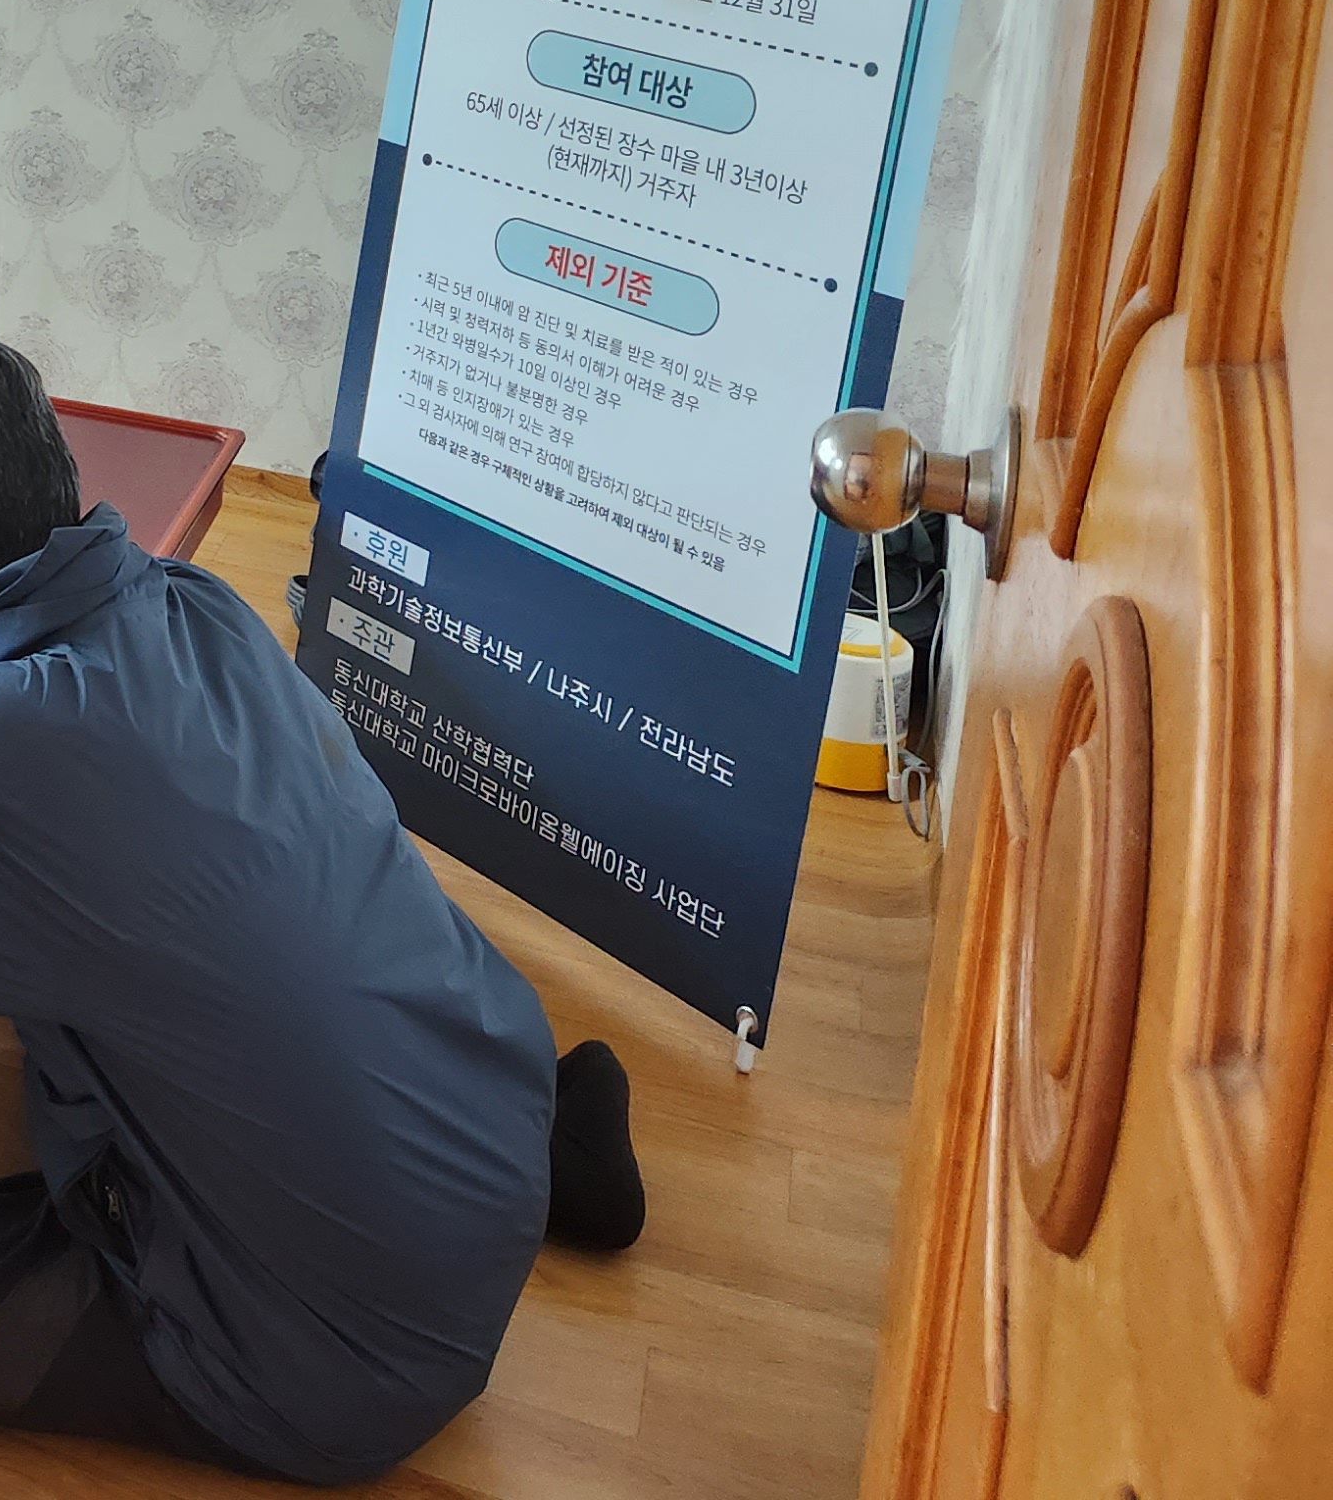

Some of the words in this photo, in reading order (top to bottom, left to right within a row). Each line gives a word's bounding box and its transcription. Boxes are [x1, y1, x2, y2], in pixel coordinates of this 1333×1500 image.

[582, 52, 634, 96] 참여
[637, 68, 694, 109] 대상
[465, 90, 504, 121] 65세
[506, 101, 544, 131] 이상
[557, 115, 613, 151] 선정된
[616, 130, 656, 162] 장수
[659, 143, 701, 176] 마을
[704, 156, 727, 184] 내
[728, 163, 808, 205] 3년이상
[547, 143, 632, 192] (현재까지)
[635, 170, 697, 209] 거주자
[545, 244, 595, 288] 제외
[600, 262, 653, 307] 기준
[411, 343, 461, 376] 거주지가
[464, 363, 502, 393] 없거나
[505, 379, 558, 415] 불분명한
[560, 402, 588, 425] 경우
[416, 318, 449, 344] 1년간
[450, 331, 514, 369] 와병일수가
[516, 357, 547, 382] 10일
[549, 369, 591, 399] 이상인
[593, 385, 621, 409] 경우
[419, 295, 446, 318] 시력
[448, 304, 462, 324] 및
[464, 311, 515, 344] 청력저하
[517, 330, 531, 350] 등
[533, 336, 575, 367] 동의서
[578, 354, 619, 384] 이해가
[622, 371, 666, 401] 어려운
[669, 388, 699, 412] 경우
[423, 270, 450, 293] 최근
[450, 280, 473, 302] 5년
[475, 289, 515, 317] 이내에
[516, 304, 531, 323] 암
[533, 309, 561, 334] 진단
[563, 320, 578, 341] 및
[580, 327, 623, 357] 치료를
[626, 343, 656, 369] 받은
[658, 355, 689, 381] 적이
[691, 367, 723, 393] 있는
[726, 379, 758, 404] 경우
[408, 367, 434, 392] 치매
[435, 378, 449, 397] 등
[451, 385, 514, 425] 인지장애가
[516, 412, 544, 437] 있는
[547, 424, 574, 447] 경우
[417, 426, 448, 451] 다음과
[468, 448, 490, 469] 경우
[490, 458, 532, 488] 구체적인
[533, 476, 565, 503] 상황을
[564, 491, 611, 523] 고려하여
[609, 510, 635, 533] 제외
[635, 521, 671, 549] 대상이
[685, 544, 699, 561] 수
[699, 549, 726, 573] 있음
[431, 402, 480, 437] 검사자에
[480, 423, 507, 448] 의해
[507, 434, 534, 458] 연구
[534, 446, 575, 477] 참여에
[576, 463, 630, 500] 합당하지
[631, 486, 673, 518] 않다고
[675, 505, 733, 544] 판단되는
[735, 530, 766, 556] 경우
[360, 530, 408, 577] 후원
[347, 615, 395, 662] 주관
[347, 565, 523, 673] 과학기술정보통신부
[545, 666, 613, 723] 나주시
[639, 714, 736, 787] 전라남도
[333, 657, 427, 729] 동신대학교
[431, 714, 534, 790] 산학협력단
[327, 687, 417, 759] 동신대학교
[421, 742, 646, 892] 마이크로바이옴웰에이징
[650, 877, 725, 938] 사업단
